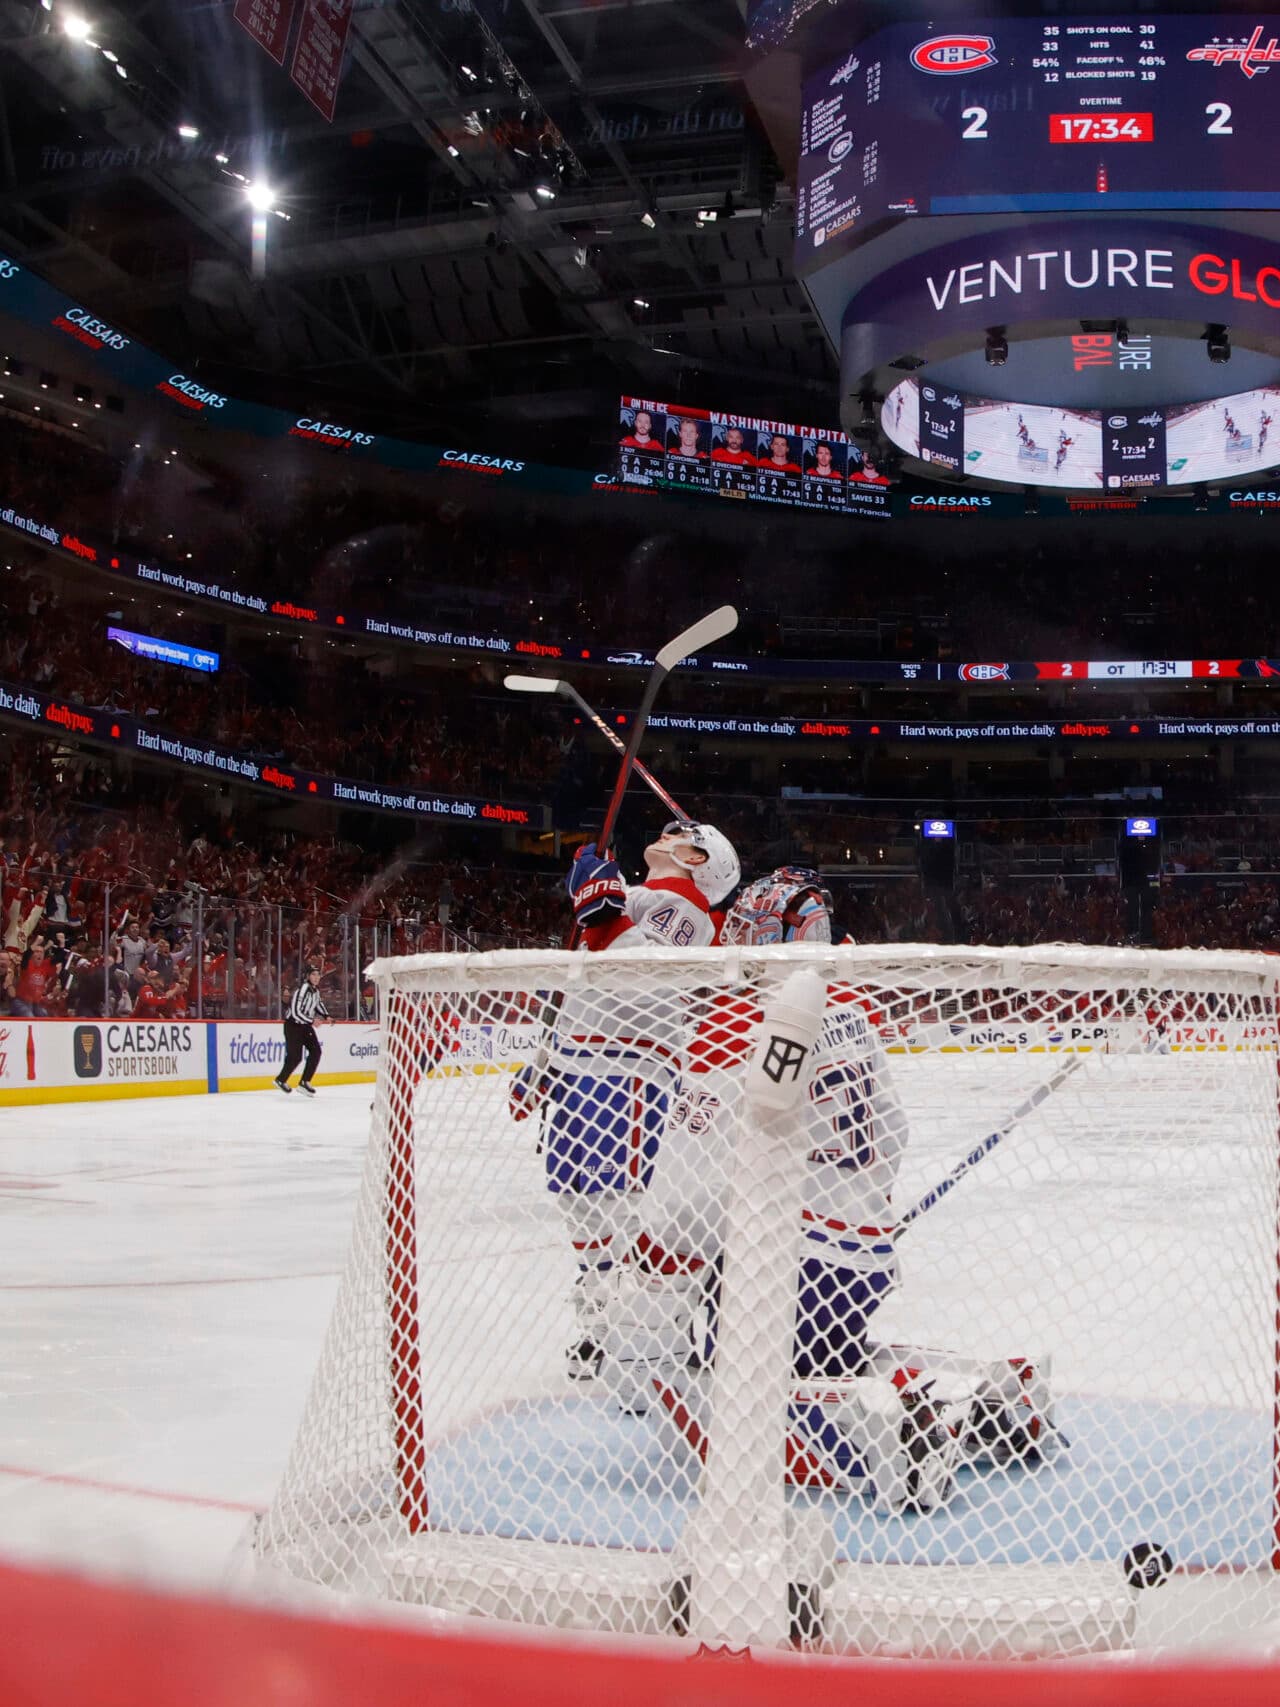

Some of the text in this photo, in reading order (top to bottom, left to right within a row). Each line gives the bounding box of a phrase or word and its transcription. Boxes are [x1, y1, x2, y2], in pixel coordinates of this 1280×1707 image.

[1043, 27, 1060, 36] 35
[1139, 25, 1156, 34] 30
[1043, 42, 1058, 51] 33
[1140, 40, 1154, 49] 41
[1032, 58, 1059, 68] 54%
[1044, 70, 1156, 82] 12 BLOCKED SHOTS 19
[1080, 97, 1122, 105] OVERTIME
[961, 107, 988, 138] 2
[1205, 102, 1233, 134] 2
[1060, 118, 1142, 139] 17:34
[826, 206, 861, 233] CAESARS
[926, 249, 1174, 311] VENTURE
[65, 308, 130, 350] CAESARS
[168, 374, 228, 409] CAESARS
[631, 398, 851, 445] ON THE ICE WASHINGTON CAPITA
[924, 411, 930, 424] 2
[295, 418, 374, 446] CAESARS
[949, 420, 955, 432] 2
[1112, 439, 1119, 451] 2
[1121, 446, 1146, 454] 17:34
[1148, 437, 1155, 449] 2
[442, 450, 525, 472] CAESARS
[931, 450, 959, 467] CAESARS
[1122, 474, 1160, 483] CAESARS
[851, 494, 885, 505] SAVES 33
[910, 495, 992, 506] CAESARS
[138, 564, 160, 585] Hard
[162, 570, 184, 589] work
[185, 579, 206, 595] pays
[207, 584, 219, 598] off
[219, 590, 231, 602] on
[232, 591, 245, 605] the
[904, 670, 917, 679] 35
[1061, 661, 1220, 677] 2 OT 17:34 2
[900, 725, 926, 736] Hard
[927, 725, 953, 736] work
[955, 728, 978, 739] pays
[980, 724, 995, 736] off
[999, 727, 1010, 736] on
[1012, 725, 1028, 735] the
[334, 783, 356, 799] Hard
[358, 789, 382, 804] work
[382, 795, 402, 808] pays
[403, 796, 416, 809] off
[417, 800, 431, 811] on
[432, 799, 450, 813] the
[647, 904, 696, 947] 48
[107, 1025, 192, 1053] CAESARS
[350, 1043, 380, 1059] Capita
[108, 1056, 178, 1077] SPORTSBOOK
